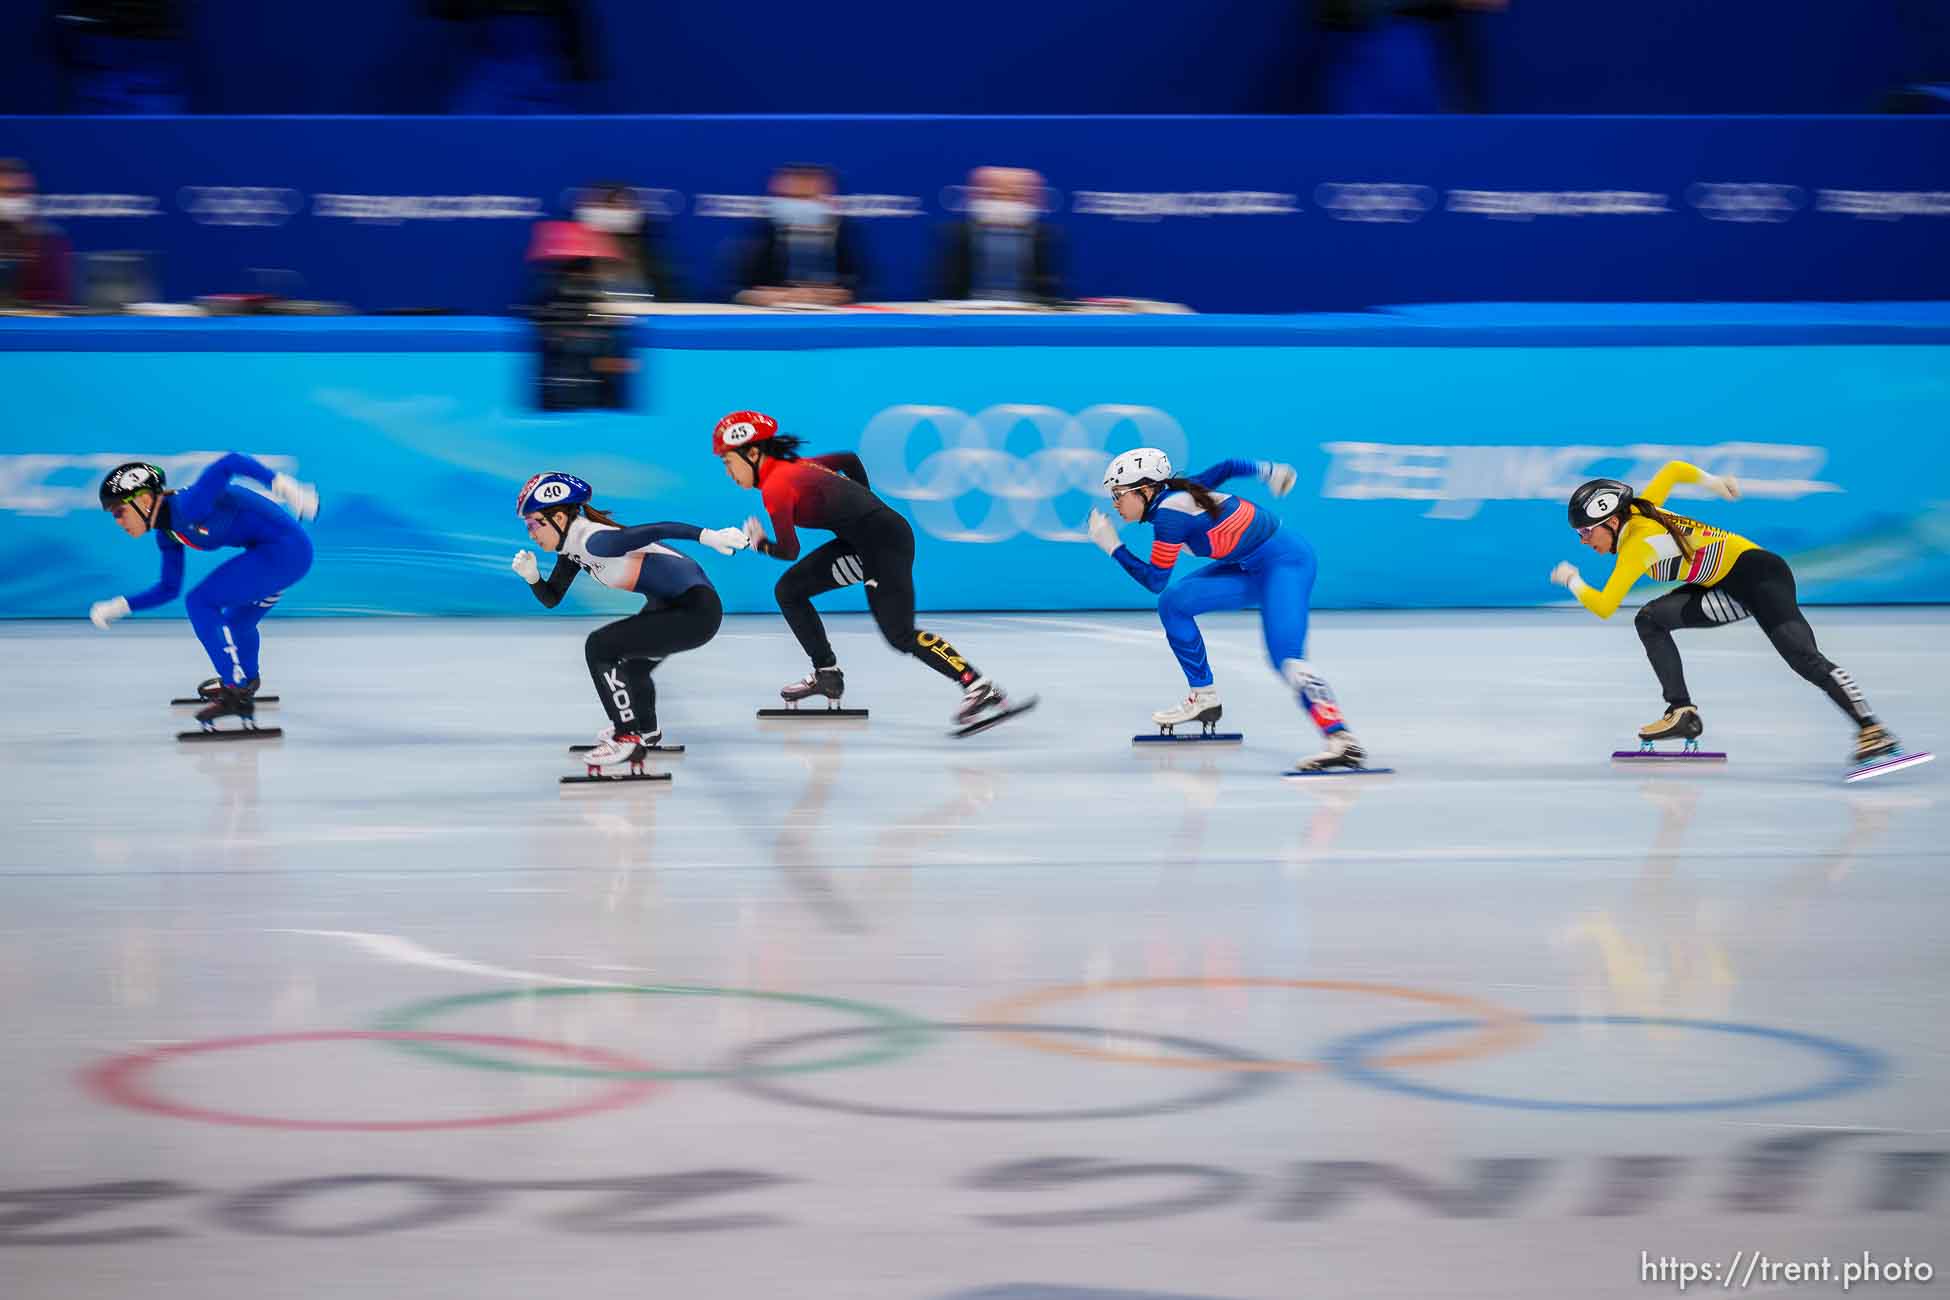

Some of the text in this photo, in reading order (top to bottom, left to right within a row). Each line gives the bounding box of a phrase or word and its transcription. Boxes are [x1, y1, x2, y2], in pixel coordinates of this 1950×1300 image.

[731, 426, 749, 441] 45
[1134, 457, 1143, 469] 7
[543, 485, 562, 498] 40
[1597, 498, 1608, 511] 5
